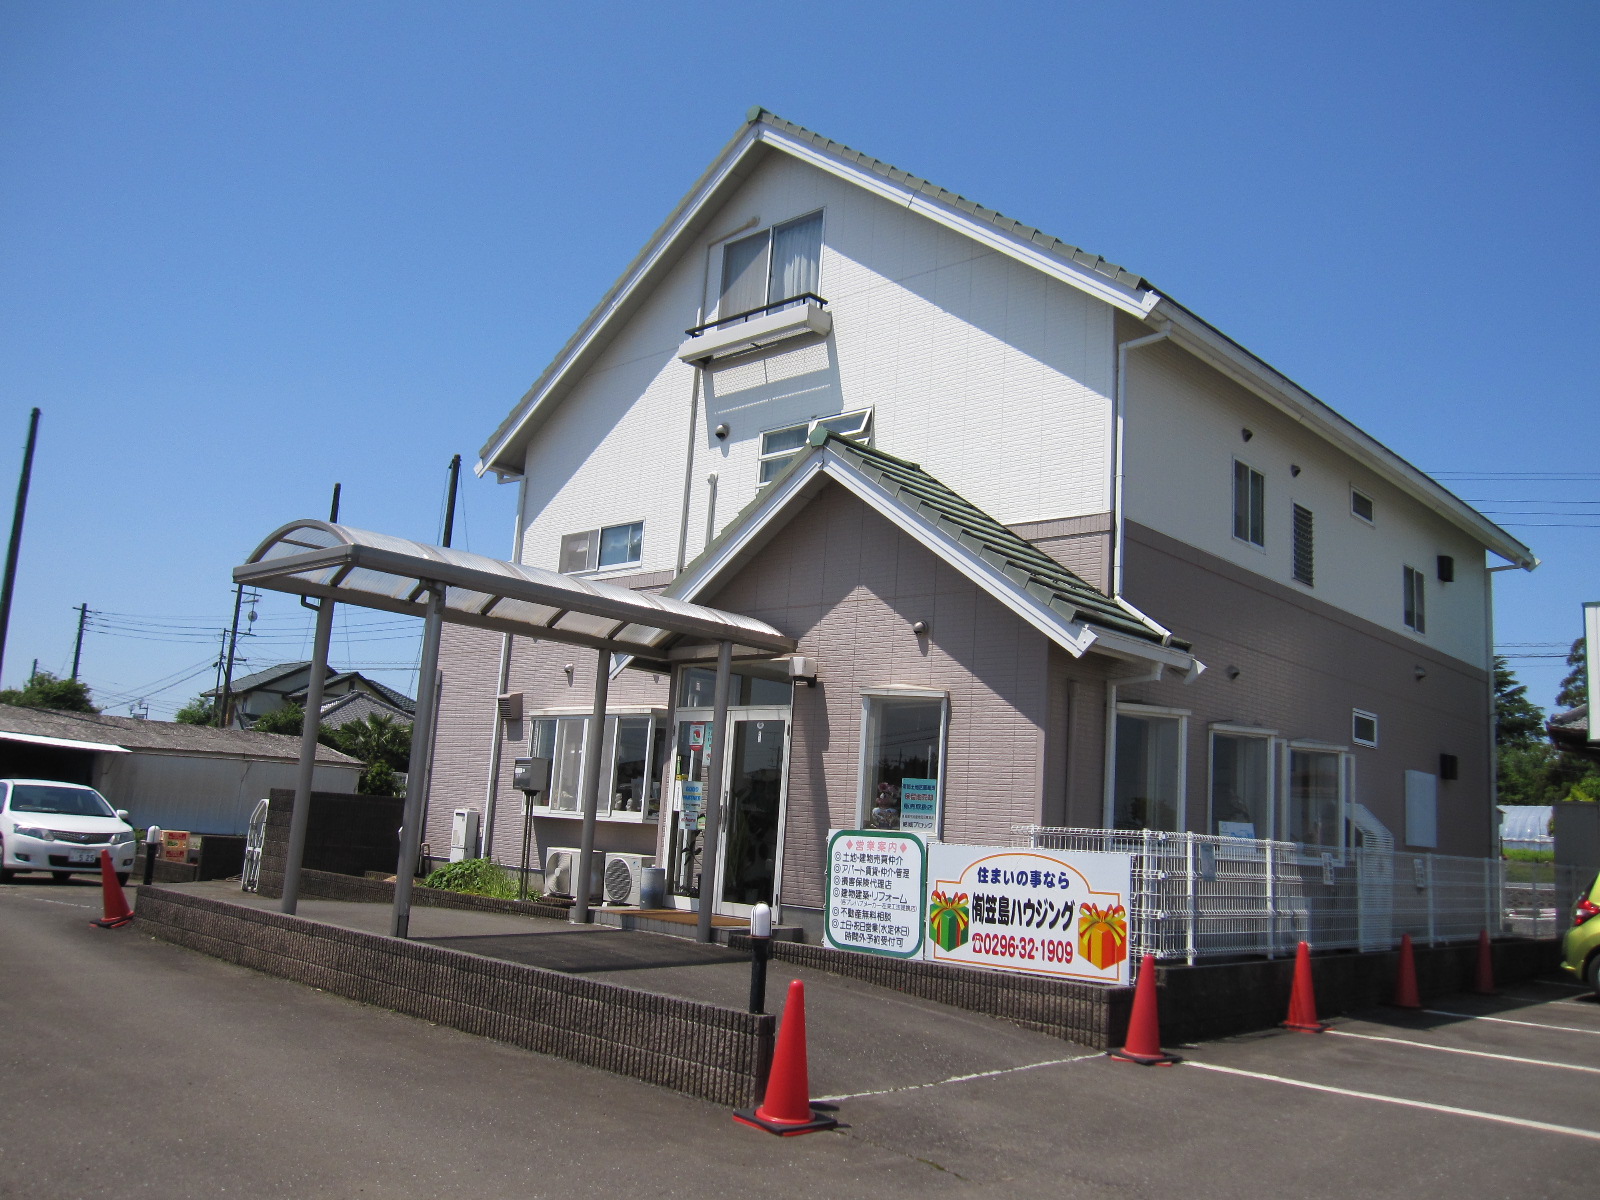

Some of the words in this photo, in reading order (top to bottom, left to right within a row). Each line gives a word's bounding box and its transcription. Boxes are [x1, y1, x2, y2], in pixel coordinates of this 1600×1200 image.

[856, 840, 897, 853] 営業案内
[841, 877, 893, 890] 損害保険代理店
[977, 866, 1070, 889] 住まいの事なら
[840, 907, 892, 922] 不動産無料相談
[844, 931, 904, 948] 時間外予約受付可
